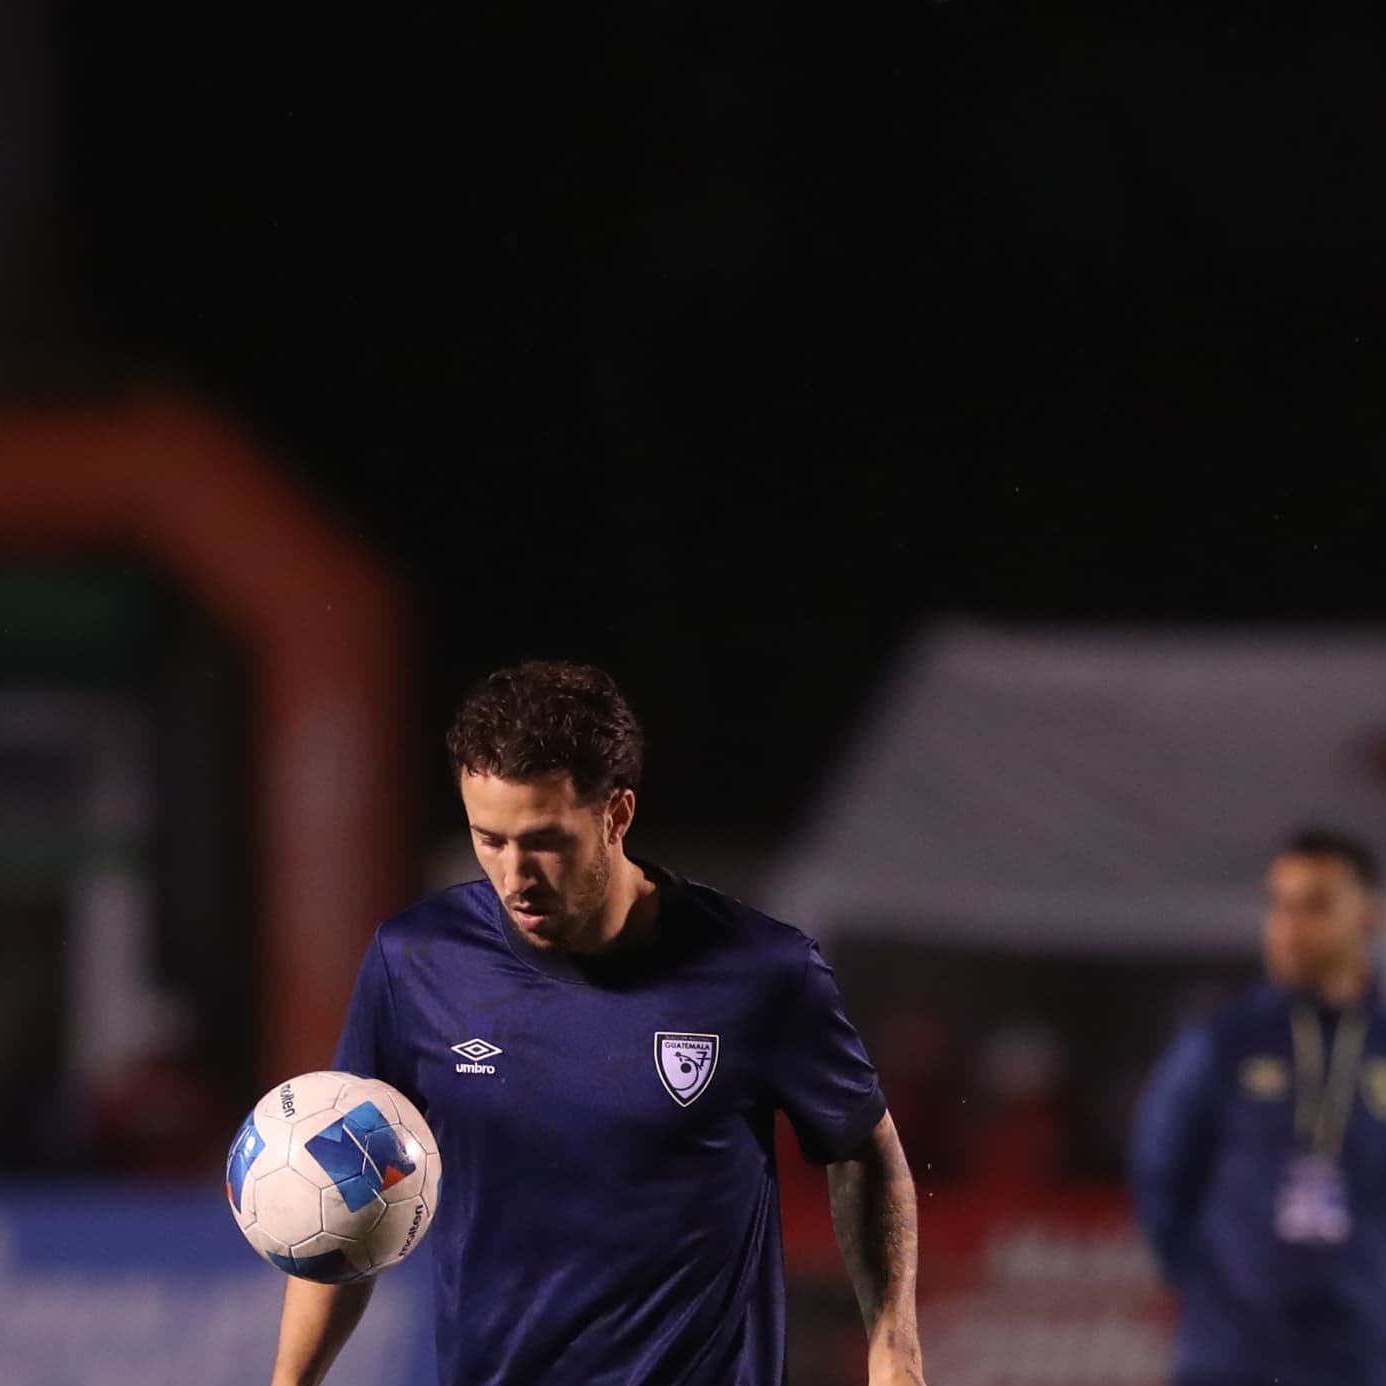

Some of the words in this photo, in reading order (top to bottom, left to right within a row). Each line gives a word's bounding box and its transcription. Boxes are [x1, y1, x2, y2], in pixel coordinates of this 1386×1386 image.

[664, 1041, 710, 1051] GUATEMALA
[456, 1062, 495, 1074] umbro
[280, 1083, 295, 1118] molten
[398, 1204, 424, 1257] molten
